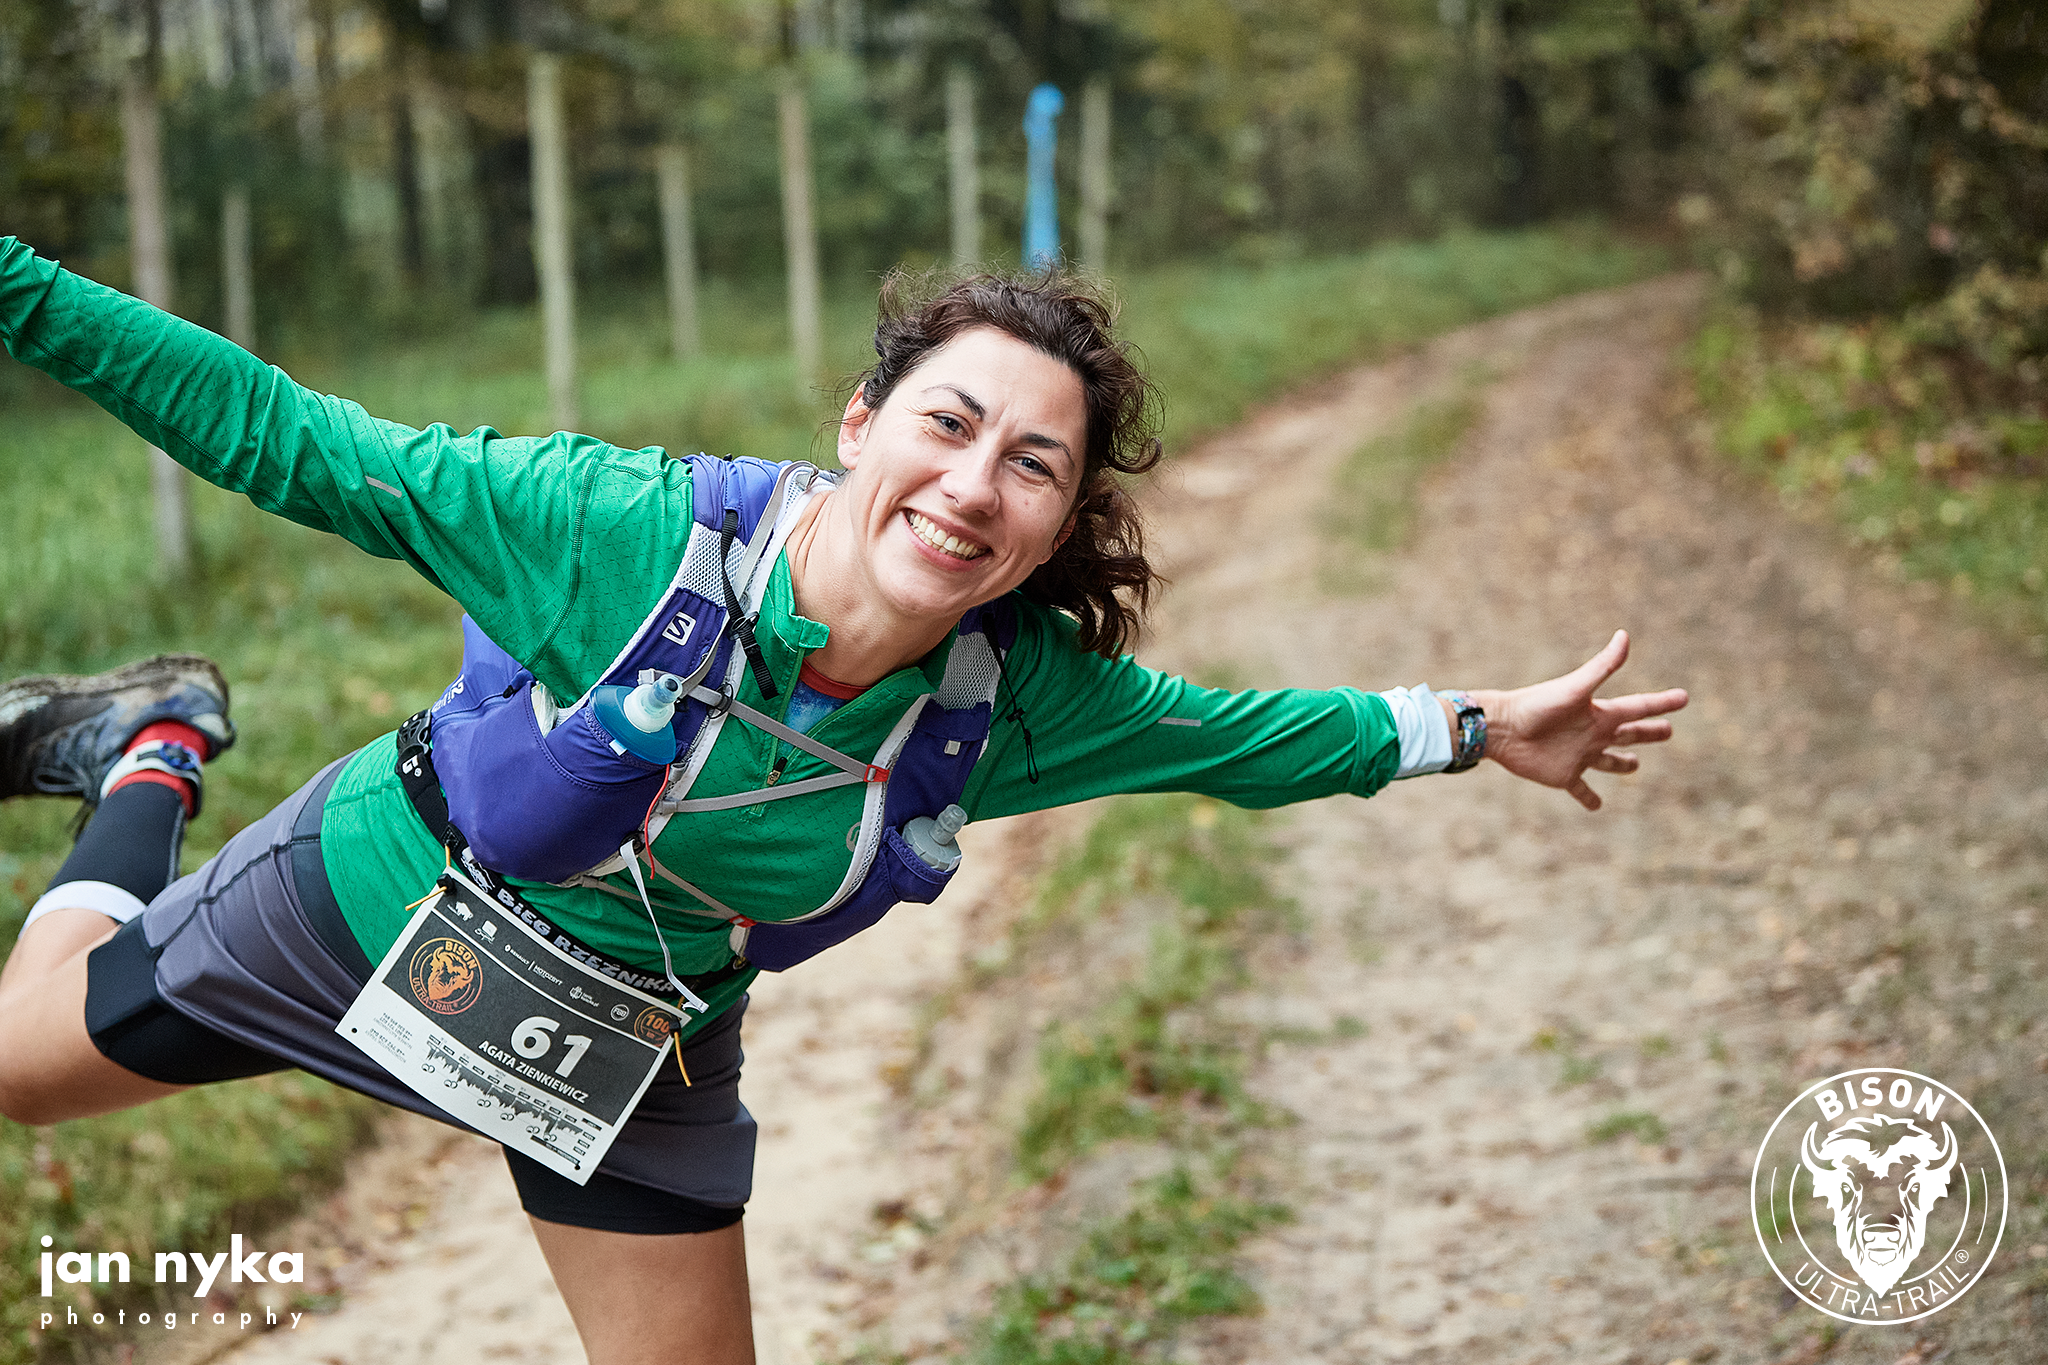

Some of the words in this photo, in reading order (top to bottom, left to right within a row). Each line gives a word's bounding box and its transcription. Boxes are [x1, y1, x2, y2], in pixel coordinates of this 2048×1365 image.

[445, 940, 478, 970] BISON
[510, 949, 530, 965] RENAULT
[645, 1014, 670, 1034] 100
[511, 1016, 592, 1078] 61
[478, 1040, 516, 1069] AGATA
[515, 1061, 589, 1104] ZIENKIEWICZ
